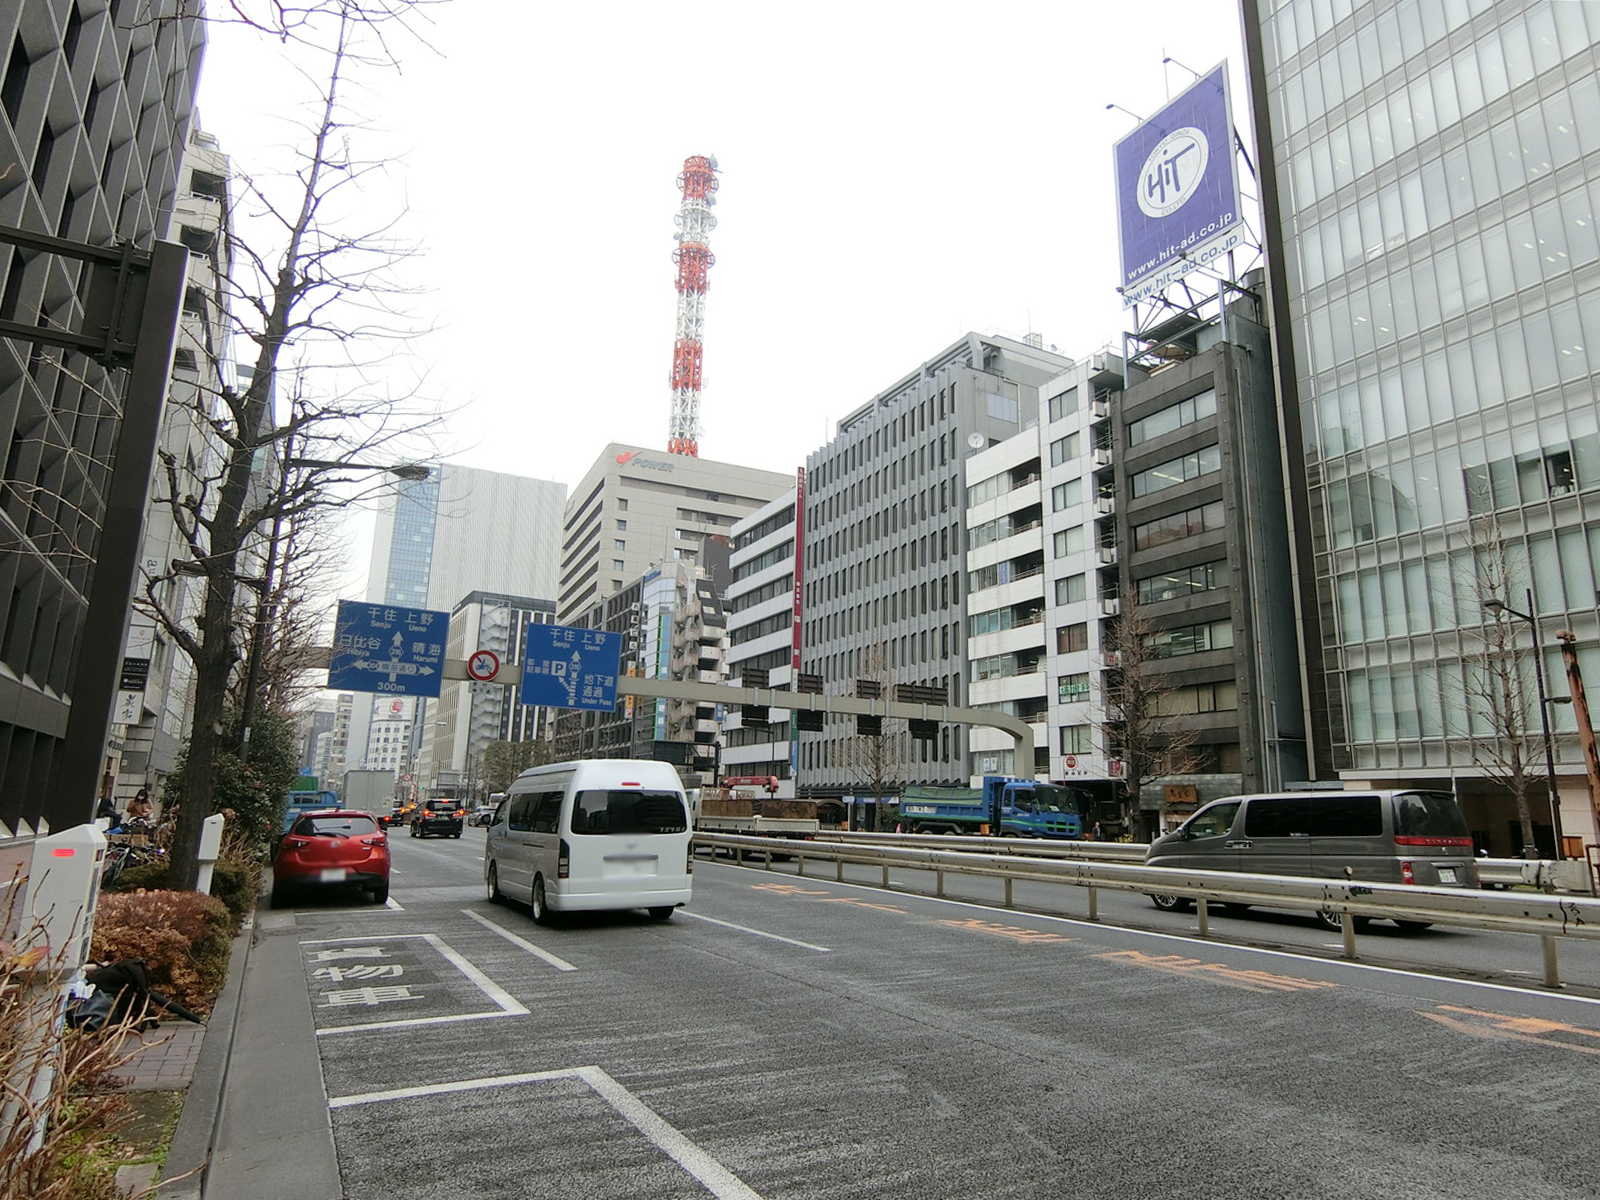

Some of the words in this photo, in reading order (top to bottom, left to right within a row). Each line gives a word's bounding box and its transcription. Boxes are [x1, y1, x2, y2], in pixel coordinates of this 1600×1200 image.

[1128, 212, 1233, 280] www.hit-ad.co.jp
[632, 457, 675, 473] POWER
[367, 606, 397, 622] 千住
[404, 611, 434, 626] 上野
[370, 620, 392, 629] Senju
[408, 624, 427, 633] Ueno
[339, 633, 381, 650] 日比谷
[550, 628, 576, 642] 千住
[581, 632, 606, 645] 上野
[412, 641, 441, 656] 晴海
[552, 640, 571, 650] Senju
[584, 644, 601, 652] Ueno
[413, 655, 438, 664] Harumi
[377, 682, 406, 692] 300m
[584, 674, 614, 687] 地下道
[582, 697, 598, 705] Under
